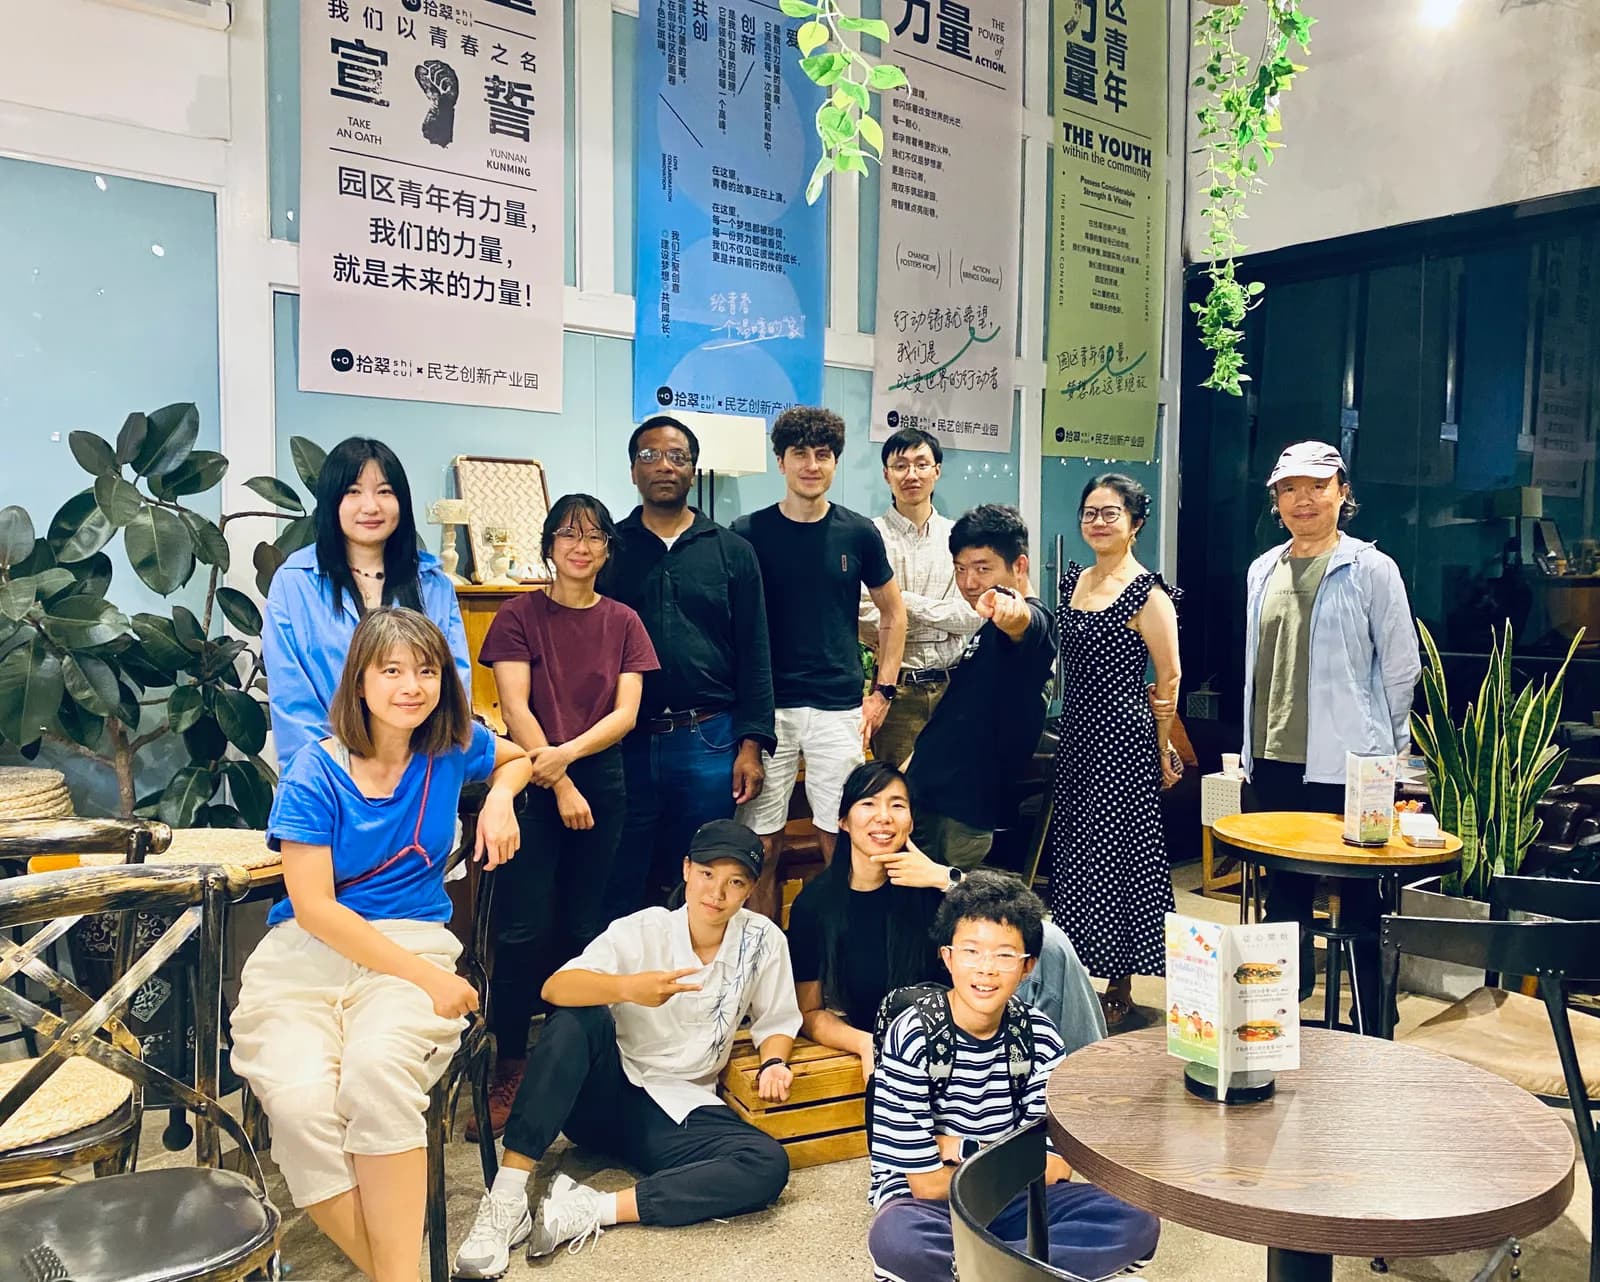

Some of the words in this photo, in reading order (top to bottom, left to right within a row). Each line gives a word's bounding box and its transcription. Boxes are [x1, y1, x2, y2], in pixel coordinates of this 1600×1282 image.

[423, 0, 454, 21] 拾翠
[692, 0, 709, 42] 共创
[327, 0, 537, 74] 我们以青春之名
[741, 14, 756, 56] 创新
[894, 0, 973, 61] 力量
[978, 27, 1005, 46] POWER
[991, 18, 1005, 32] THE
[975, 56, 1006, 74] ACTION.
[330, 37, 390, 108] 宣
[483, 74, 535, 143] 誓
[347, 116, 371, 130] TAKE
[336, 128, 352, 140] AN
[354, 130, 382, 145] OATH
[1062, 121, 1094, 150] THE
[1099, 133, 1152, 168] YOUTH
[489, 147, 527, 164] YUNNAN
[1062, 144, 1089, 161] within
[1091, 151, 1105, 166] the
[1107, 159, 1151, 182] community
[486, 160, 531, 177] KUNMING
[338, 166, 537, 233] 园区青年有力量，
[369, 216, 513, 269] 我们的力量，
[333, 252, 532, 308] 就是未来的力量！
[356, 354, 390, 375] 拾翠
[897, 340, 940, 365] 我们是
[427, 362, 539, 390] 民艺创新产业园
[674, 391, 699, 408] 拾翠
[725, 396, 802, 415] 民艺创新产
